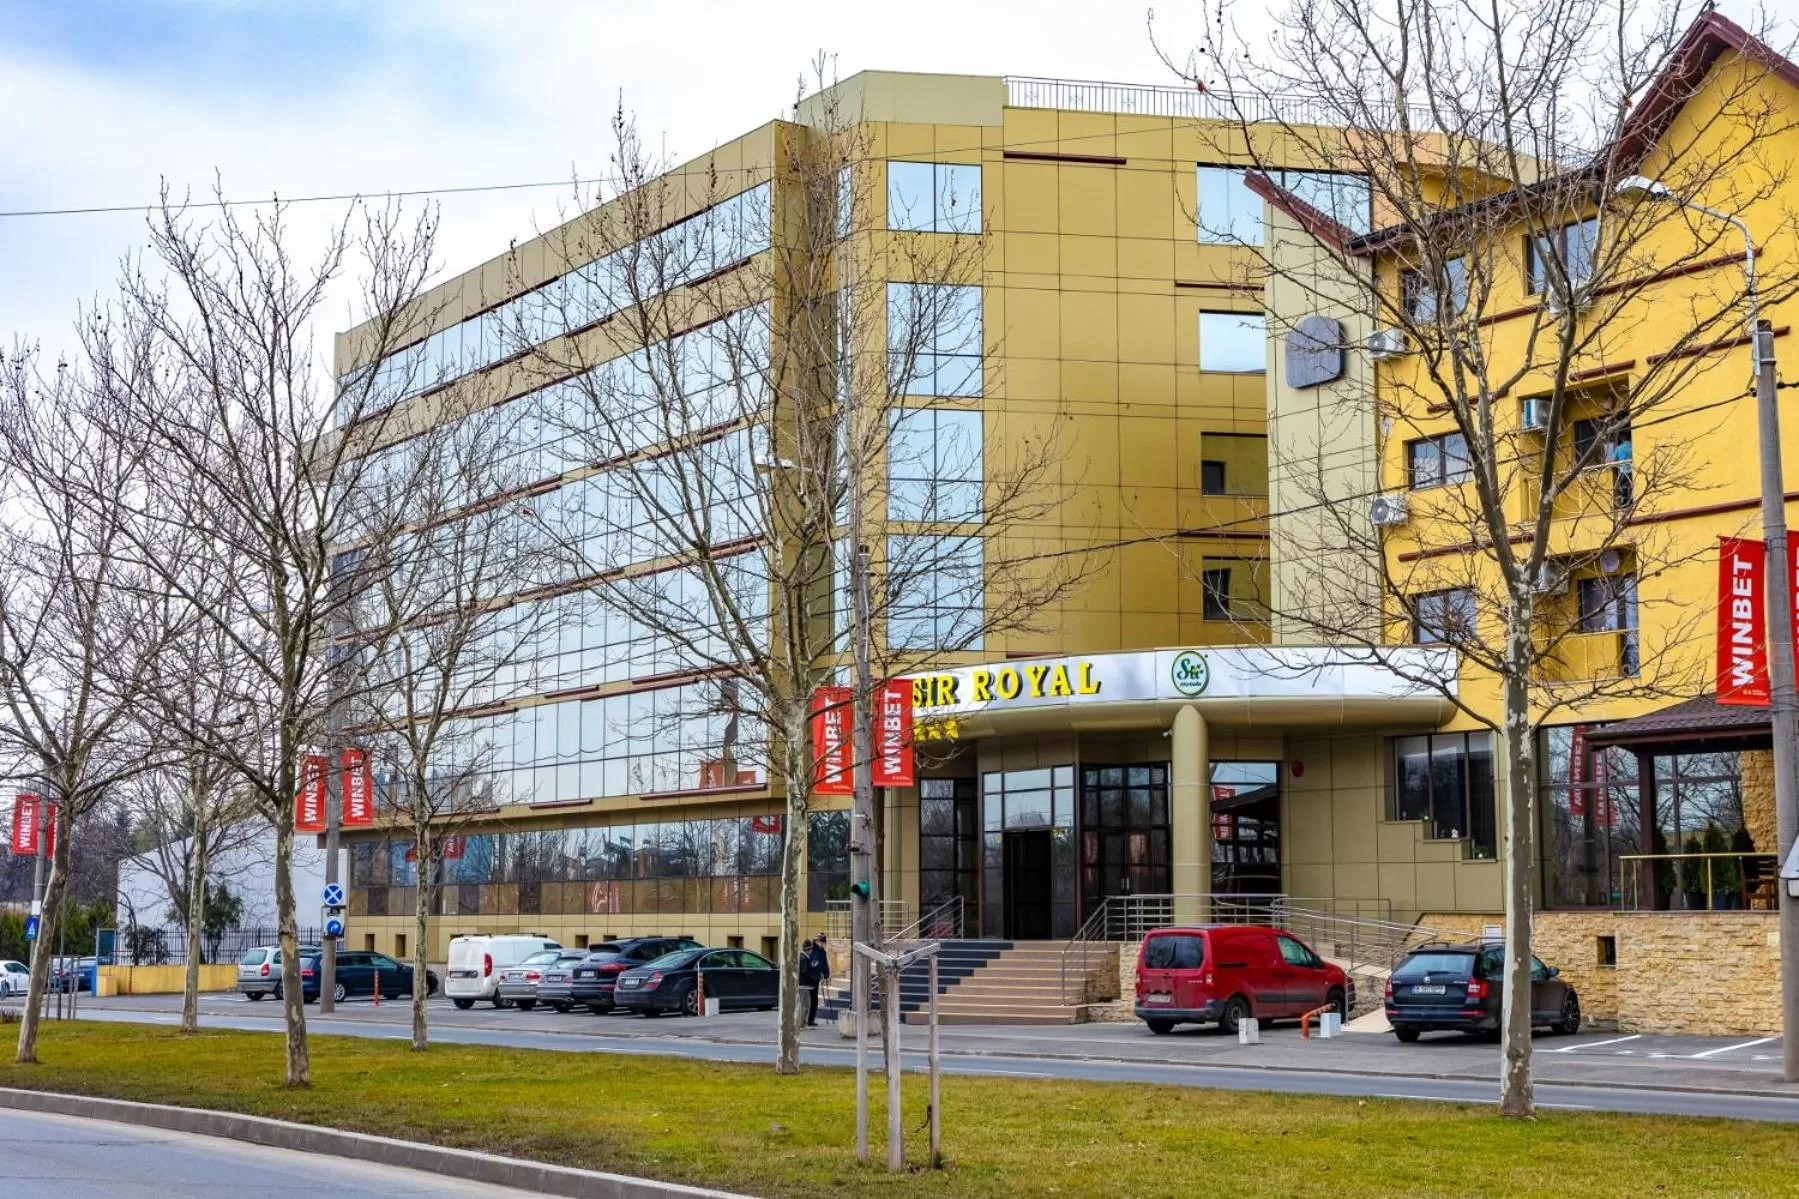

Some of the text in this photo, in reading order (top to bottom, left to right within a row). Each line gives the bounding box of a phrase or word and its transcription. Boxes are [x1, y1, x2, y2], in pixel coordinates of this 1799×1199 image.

[1732, 554, 1754, 687] WINBET
[912, 662, 1101, 707] SIR ROYAL
[825, 696, 842, 784] WINBET
[884, 689, 902, 775] WINBET
[304, 764, 320, 822] WINBET
[350, 756, 365, 817] WINBET
